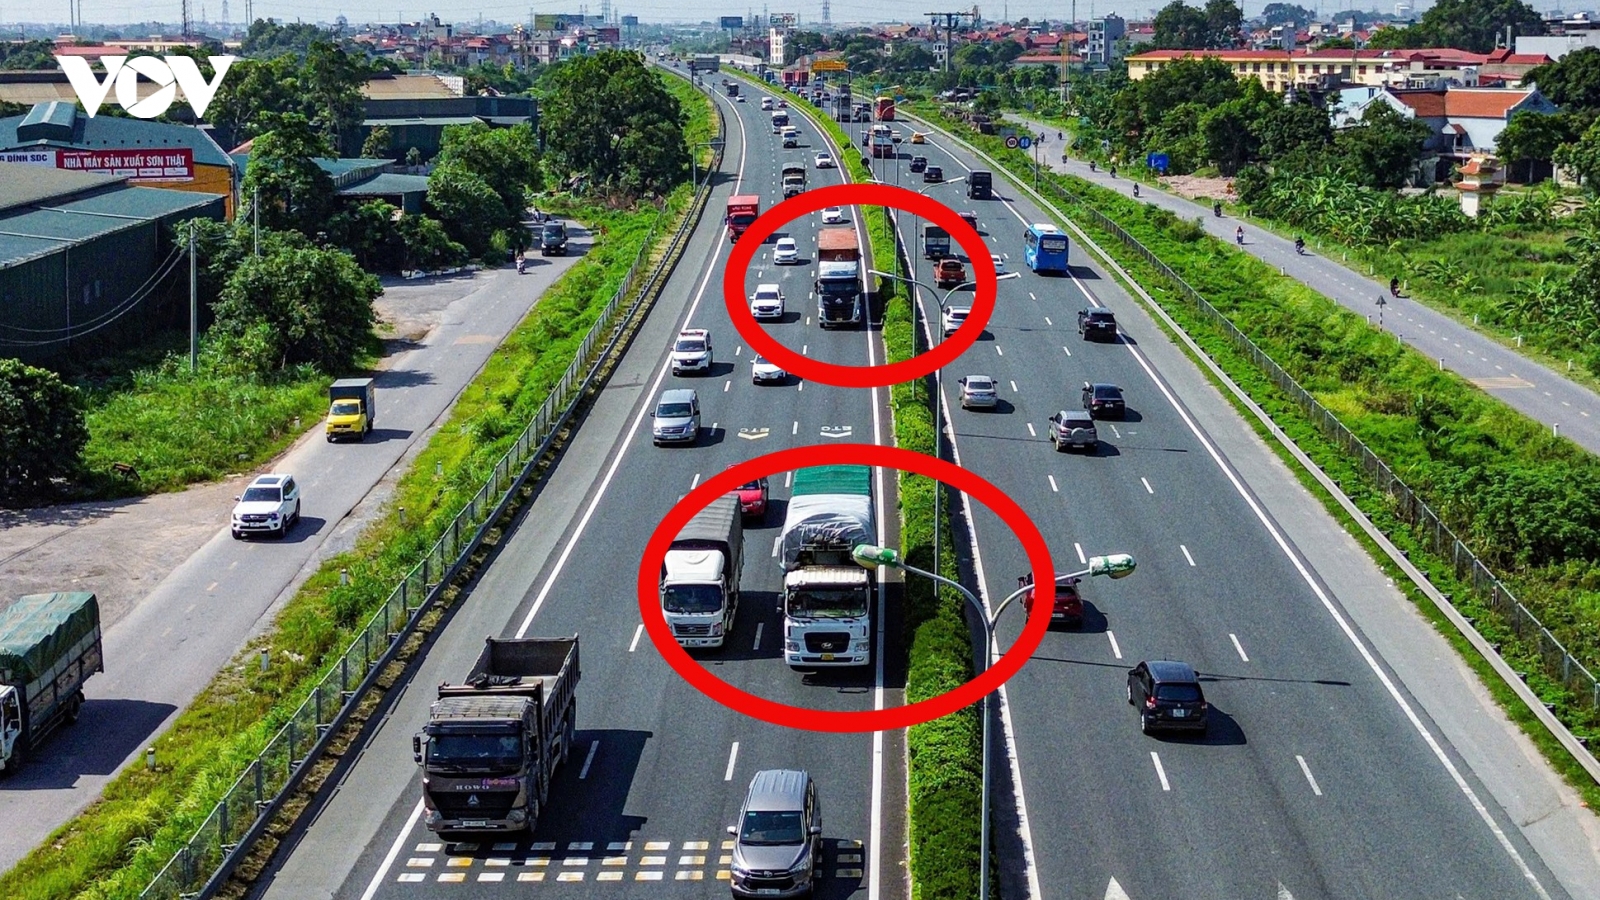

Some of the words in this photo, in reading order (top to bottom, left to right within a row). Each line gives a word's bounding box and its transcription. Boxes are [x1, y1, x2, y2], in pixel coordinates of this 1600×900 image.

[30, 154, 48, 162] SDC
[63, 155, 81, 168] NHÀ
[83, 155, 102, 168] MÁY
[104, 153, 122, 167] SẢN
[123, 153, 144, 167] XUẤT
[146, 155, 164, 167] SƠN
